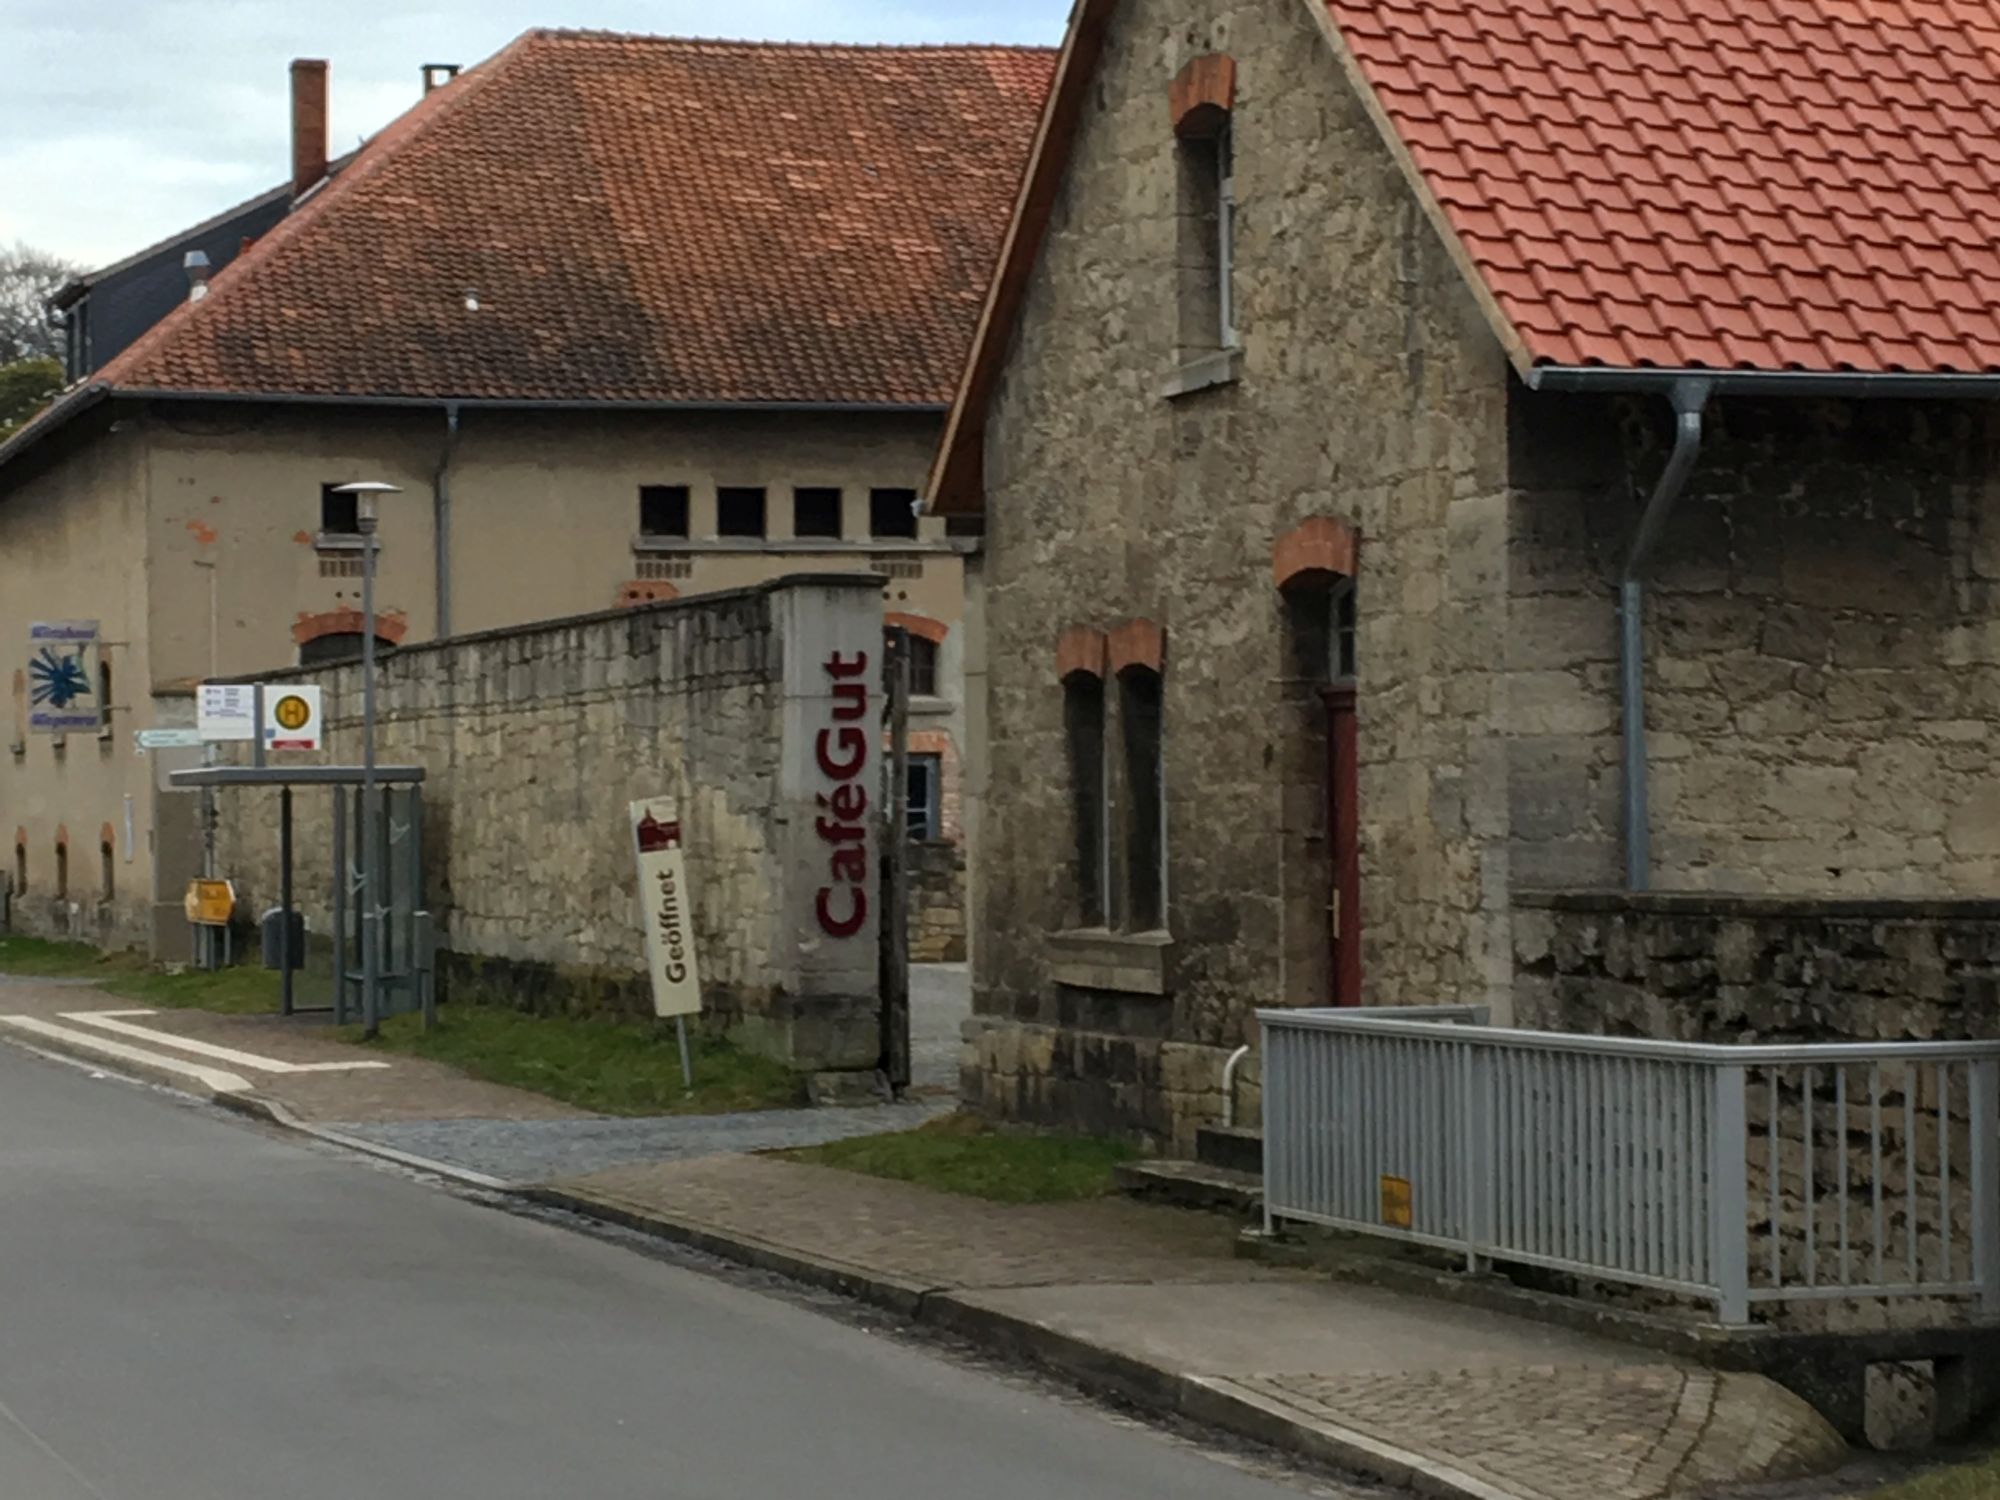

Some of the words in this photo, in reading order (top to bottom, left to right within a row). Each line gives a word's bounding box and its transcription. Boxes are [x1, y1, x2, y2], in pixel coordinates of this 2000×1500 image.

[285, 702, 299, 722] H
[816, 651, 867, 938] CaféGut
[656, 868, 687, 984] Geöffnet
